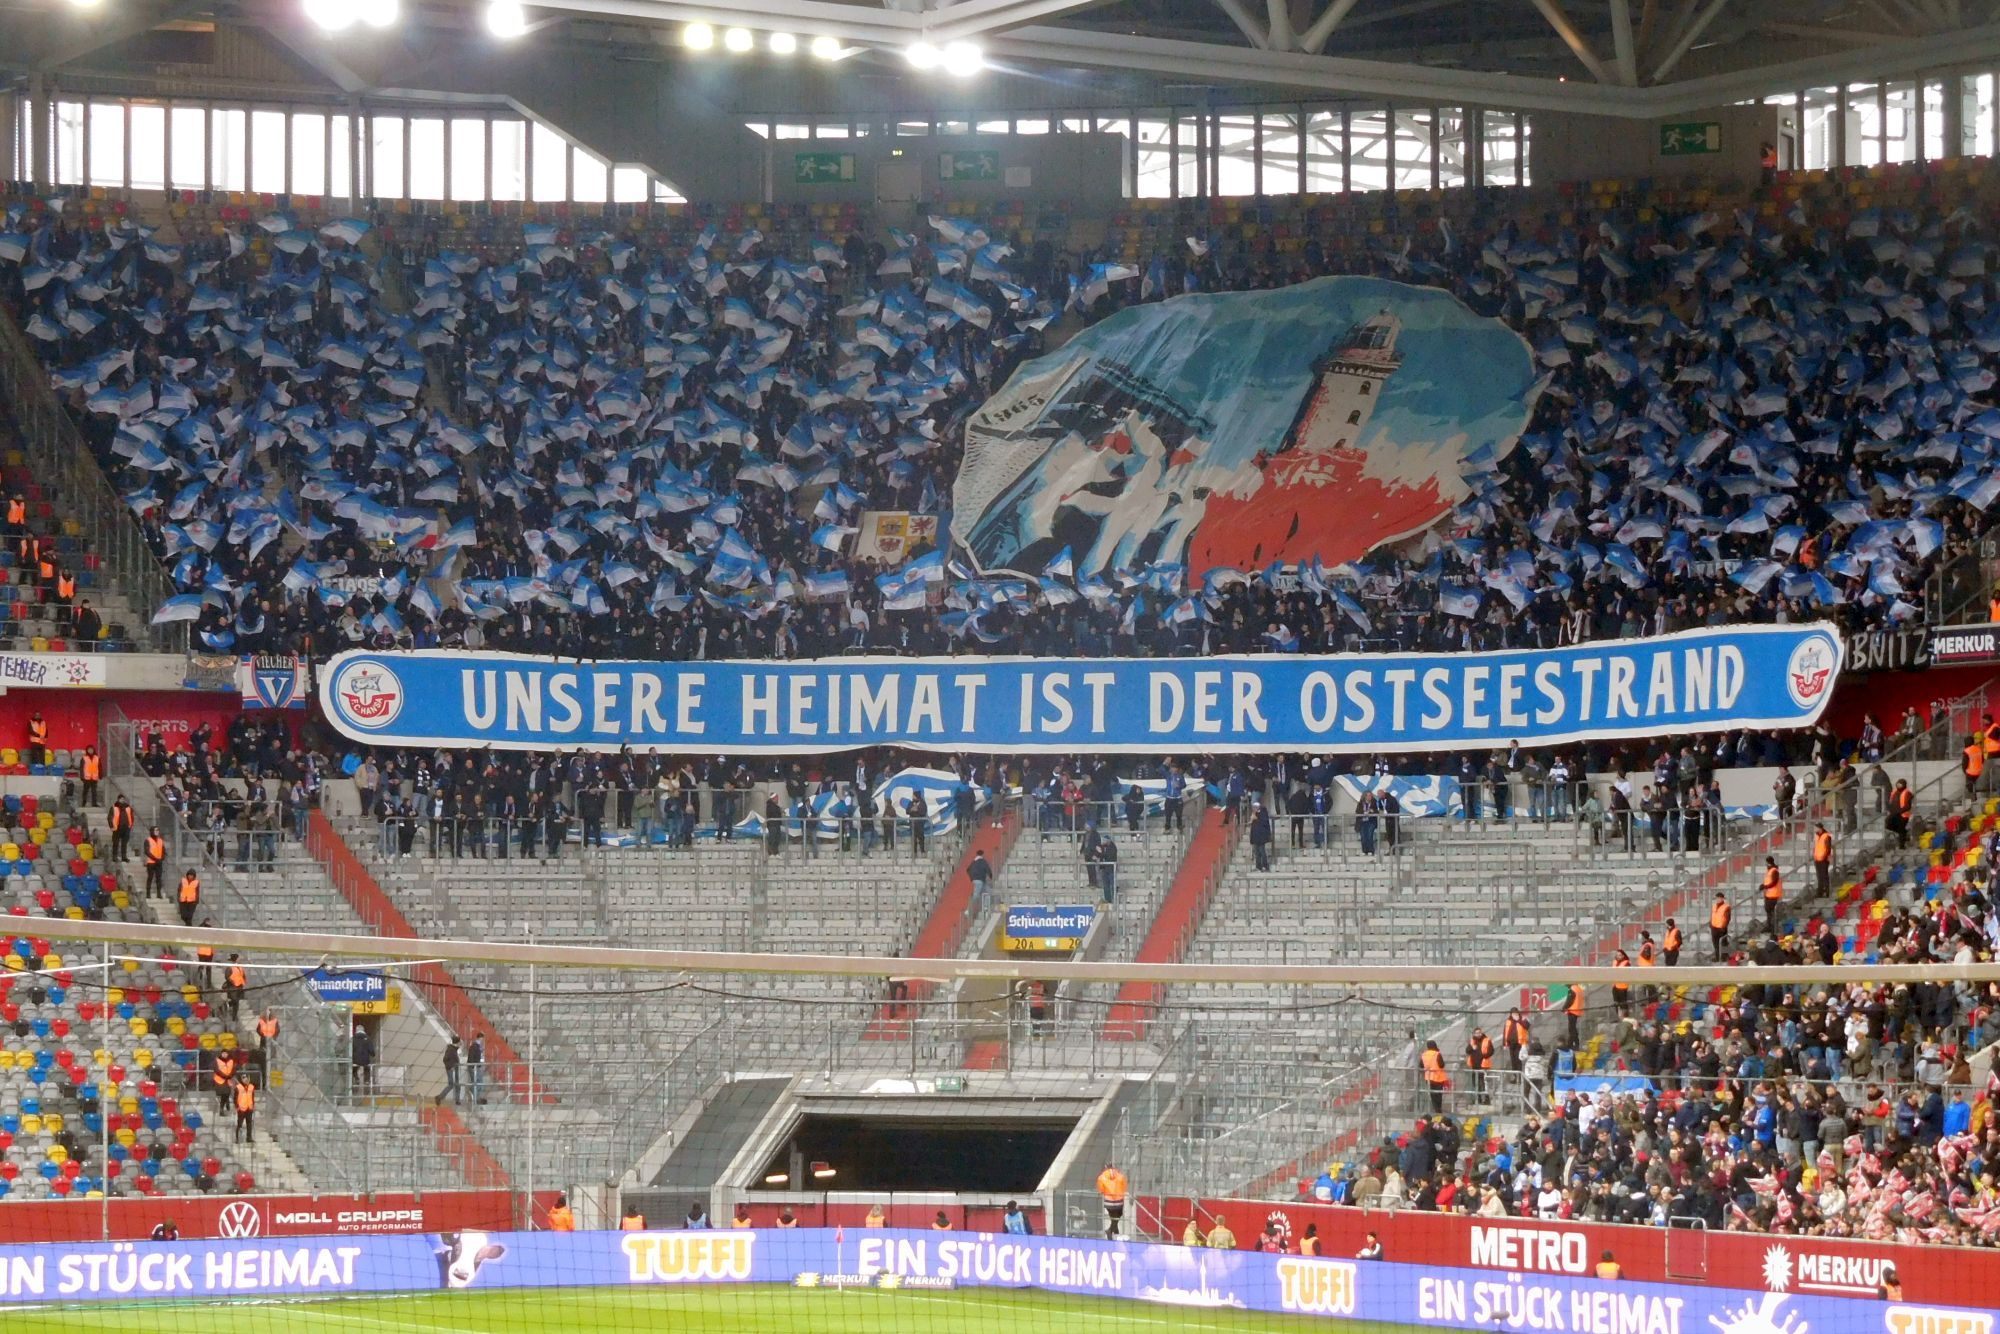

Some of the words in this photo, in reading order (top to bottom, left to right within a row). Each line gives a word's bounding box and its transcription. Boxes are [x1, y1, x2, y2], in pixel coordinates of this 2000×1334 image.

[1934, 634, 1995, 654] MERKUR
[462, 669, 705, 735] UNSERE
[741, 673, 987, 735] HEIMAT
[1019, 671, 1116, 734] IST
[1148, 671, 1268, 734] DER
[1300, 644, 1745, 734] OSTSEESTRAND
[308, 978, 363, 992] humacher
[366, 978, 382, 992] Alt
[361, 1002, 374, 1013] 19
[276, 1212, 332, 1224] MOLL
[337, 1210, 423, 1222] GRUPPE
[338, 1224, 359, 1232] AUTO
[361, 1223, 423, 1231] PERFORMANCE
[624, 1235, 752, 1280] TUFFI
[859, 1238, 926, 1276] EIN
[937, 1232, 1032, 1282] STÜCK
[1039, 1247, 1126, 1289] HEIMAT
[1470, 1226, 1587, 1273] METRO
[58, 1243, 193, 1293] STÜCK
[205, 1247, 361, 1290] HEIMAT
[823, 1274, 870, 1284] MERKUR
[905, 1276, 952, 1286] MERKUR
[1279, 1260, 1354, 1312] TUFFI
[1419, 1277, 1466, 1321] EIN
[1473, 1272, 1565, 1330] STÜCK
[1571, 1290, 1683, 1334] HEIMAT
